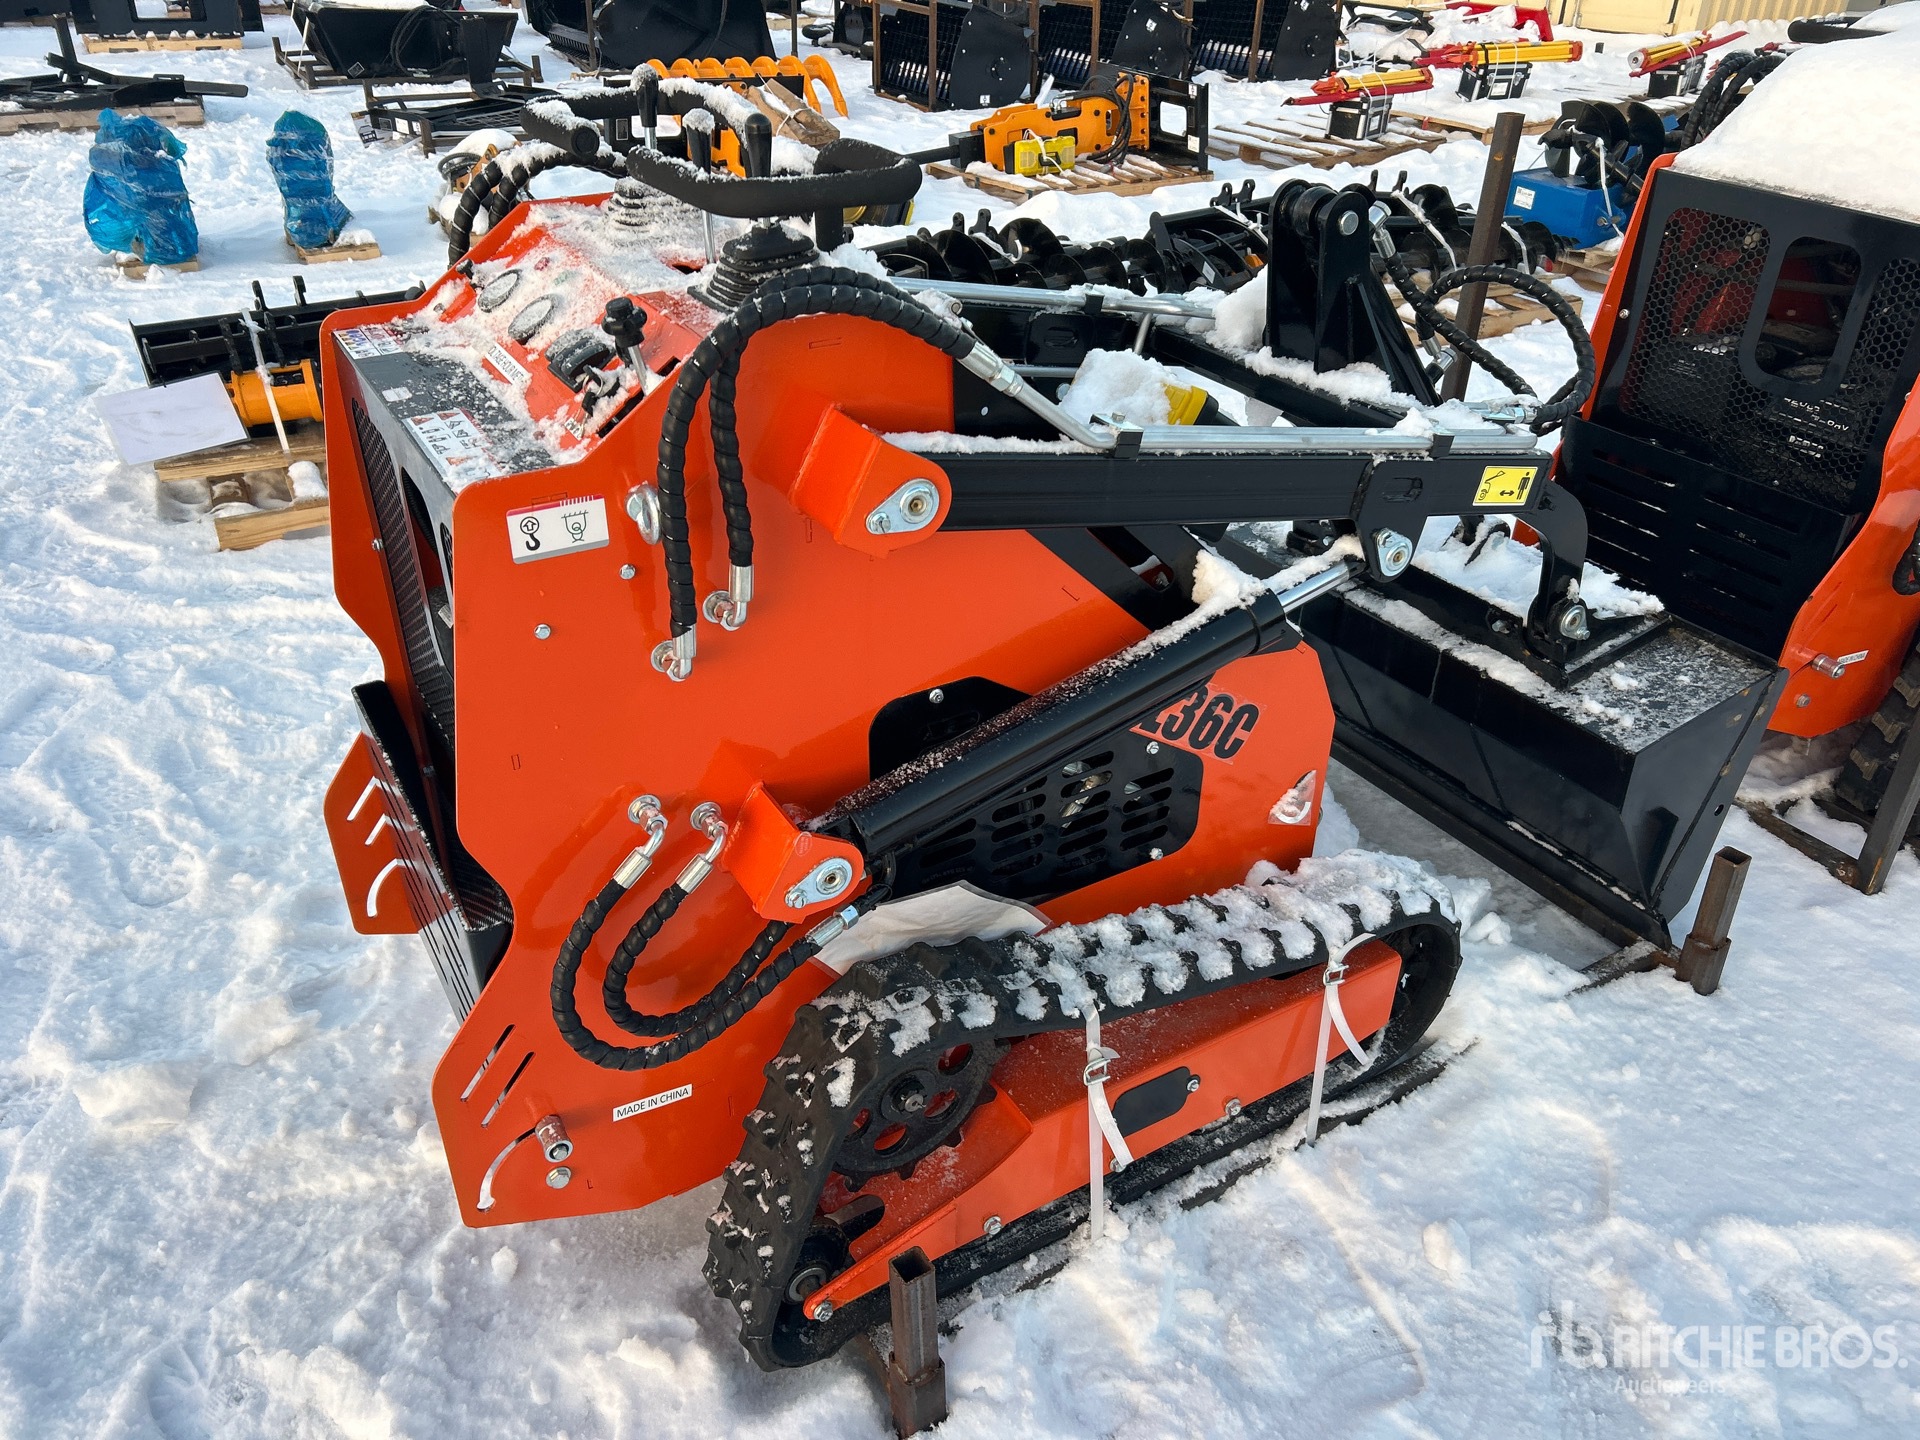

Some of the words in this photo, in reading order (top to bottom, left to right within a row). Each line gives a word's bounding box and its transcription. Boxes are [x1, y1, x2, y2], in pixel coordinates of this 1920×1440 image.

[616, 1100, 646, 1118] MADE
[648, 1097, 658, 1108] IN
[659, 1087, 689, 1104] CHINA
